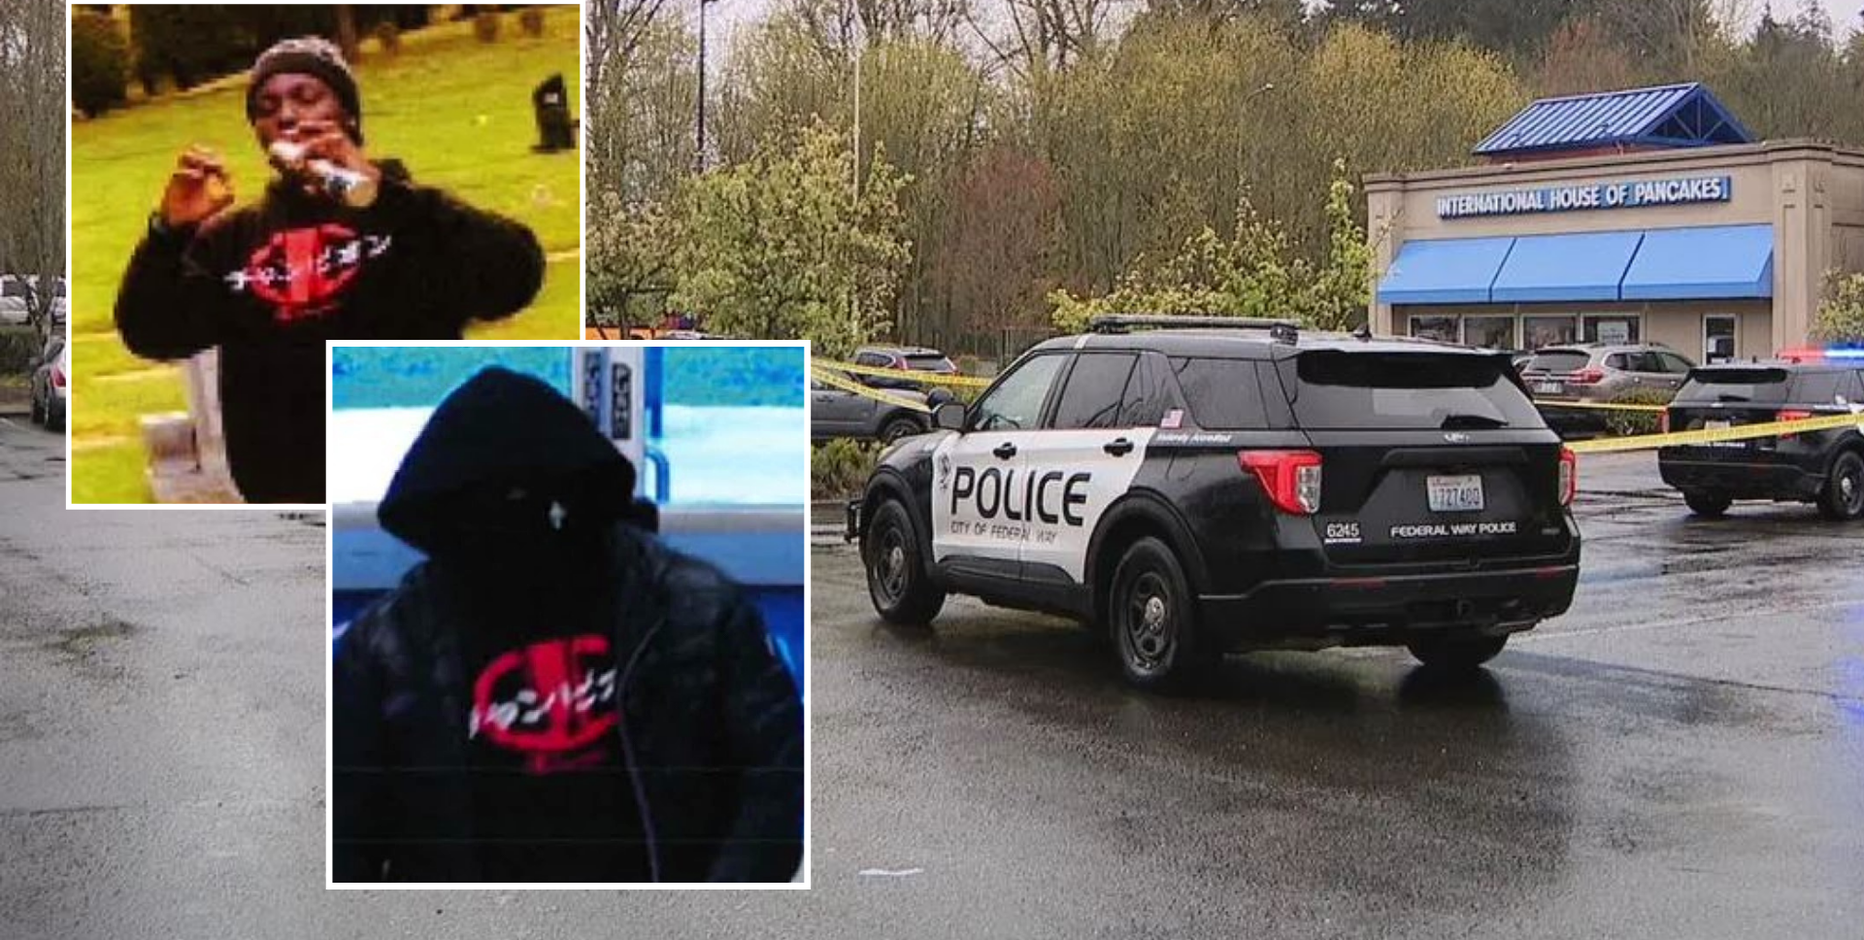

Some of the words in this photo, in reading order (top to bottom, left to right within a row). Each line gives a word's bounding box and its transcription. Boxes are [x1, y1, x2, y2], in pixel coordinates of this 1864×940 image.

[1437, 191, 1545, 217] INTERNATIONAL
[1550, 188, 1600, 210] HOUSE
[1606, 184, 1628, 205] OF
[1635, 178, 1722, 203] PANCAKES
[951, 466, 1092, 527] POLICE
[950, 521, 970, 534] CITY
[974, 522, 987, 535] OF
[1390, 524, 1449, 538] FEDERAL
[1450, 523, 1477, 536] WAY
[1478, 521, 1517, 534] POLICE
